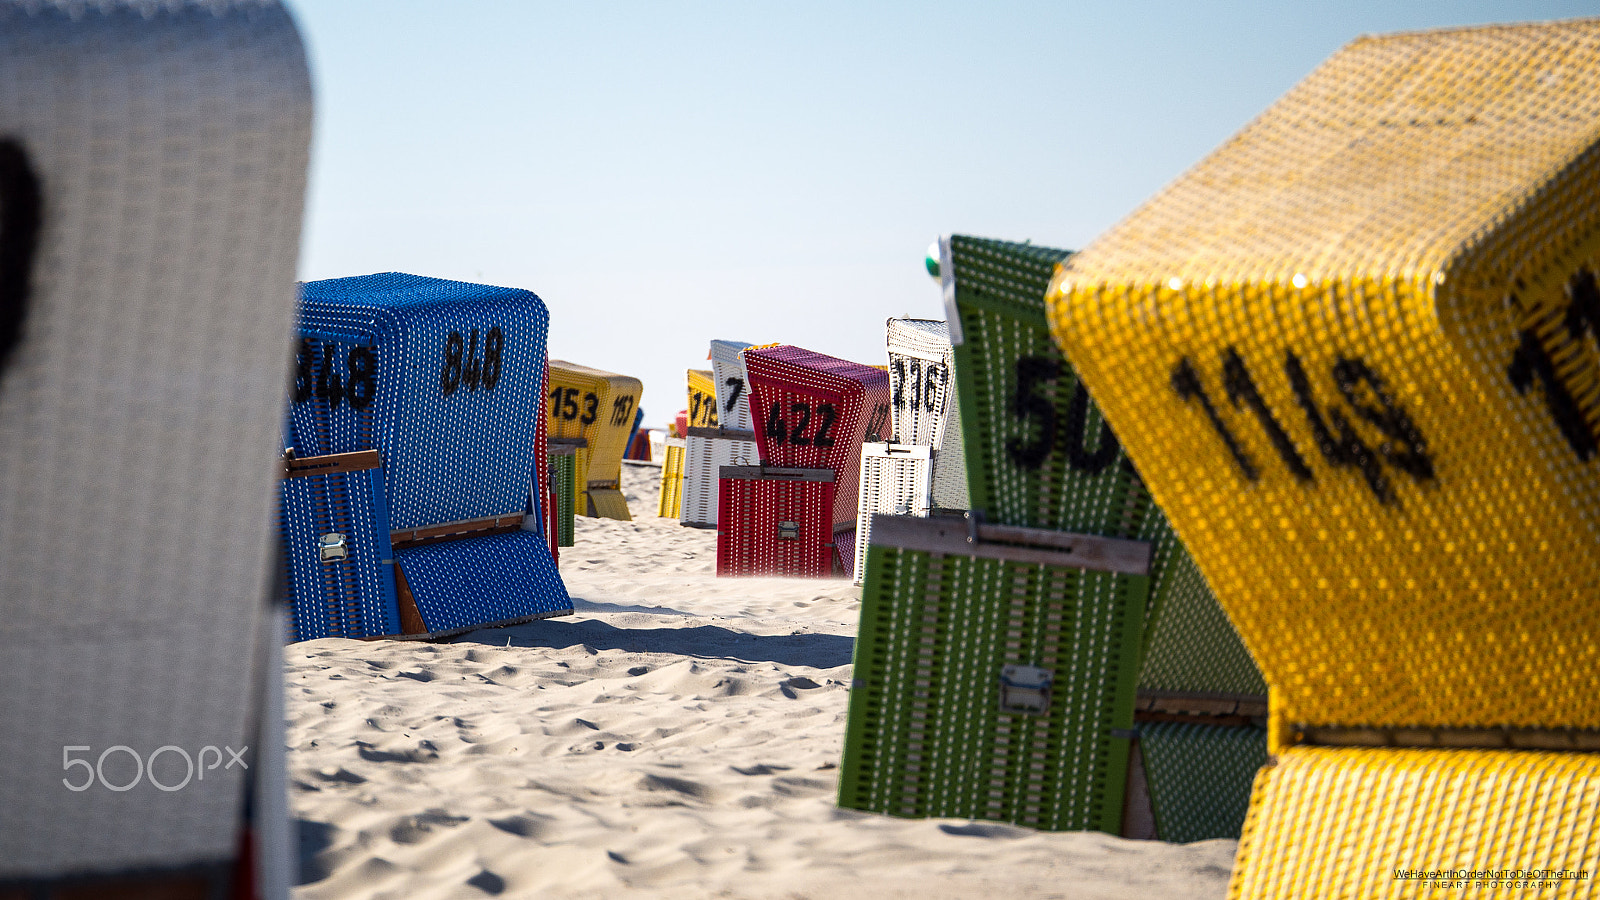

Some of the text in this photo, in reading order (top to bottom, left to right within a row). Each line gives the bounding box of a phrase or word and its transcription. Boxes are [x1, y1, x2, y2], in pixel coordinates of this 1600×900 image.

[441, 326, 503, 396] 848
[766, 401, 835, 447] 422
[1171, 346, 1440, 505] 1149
